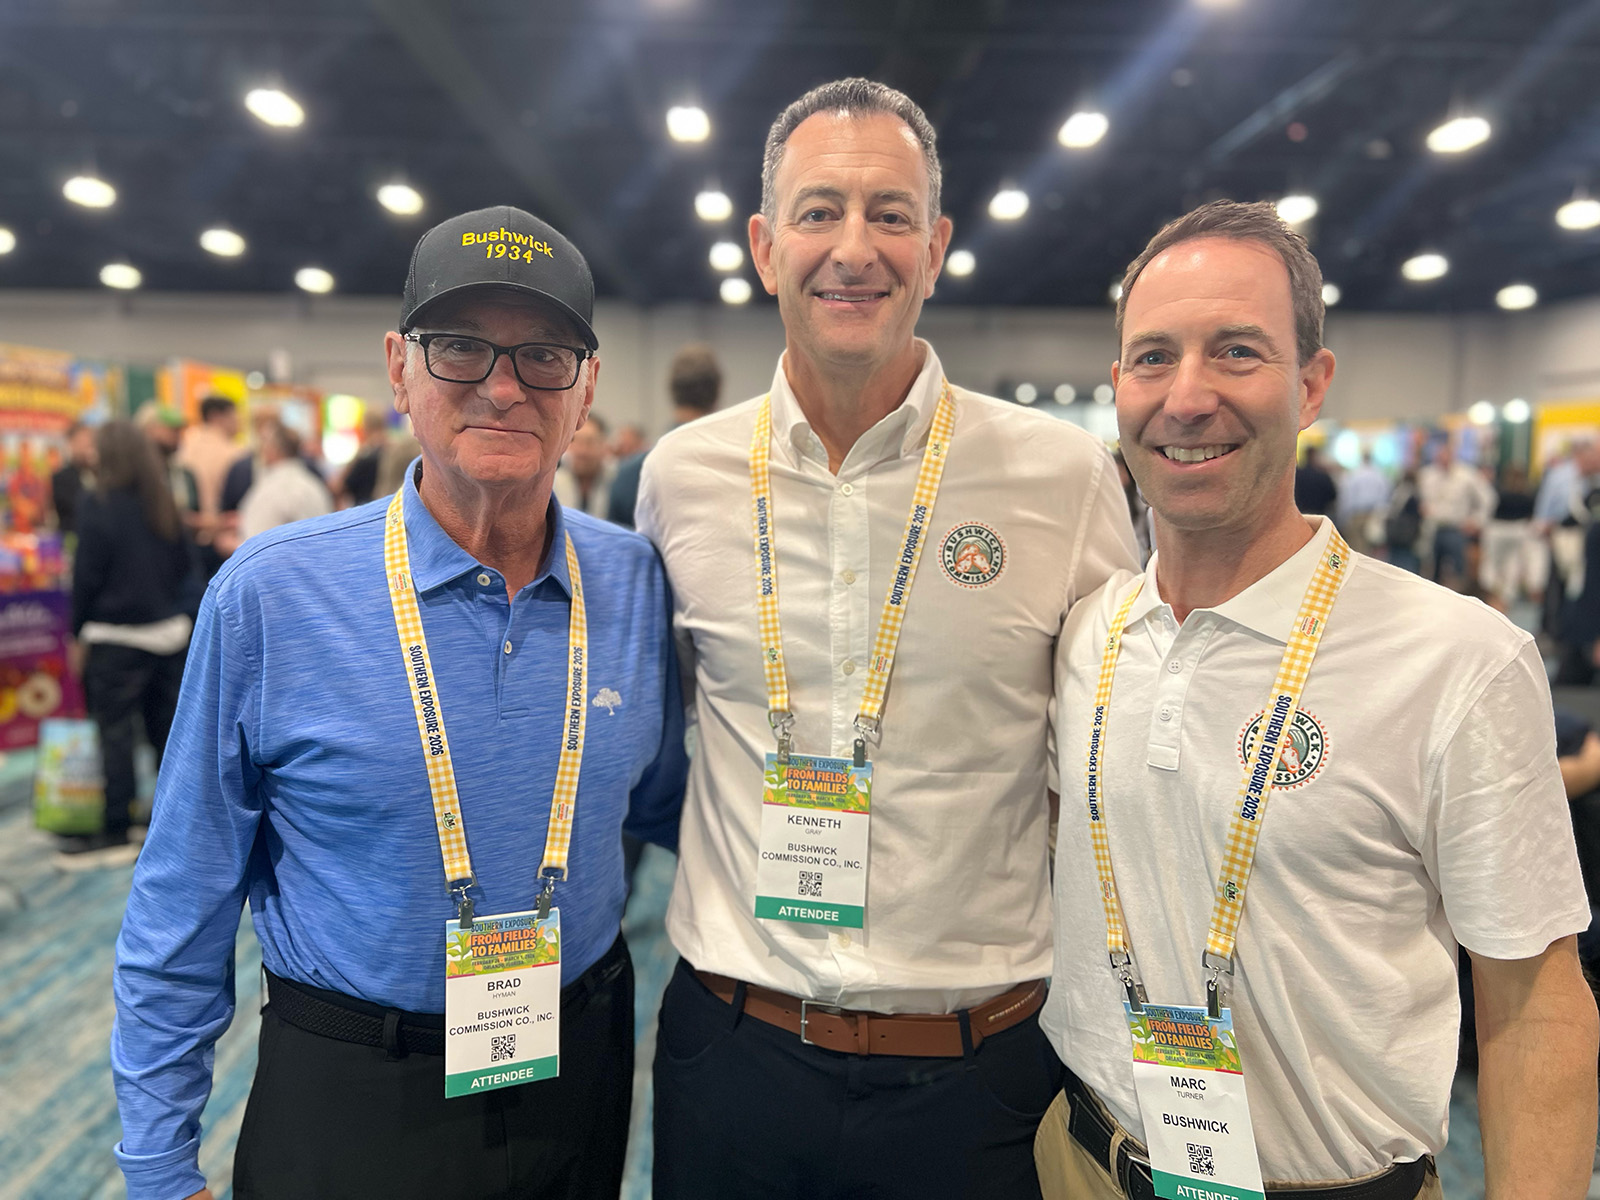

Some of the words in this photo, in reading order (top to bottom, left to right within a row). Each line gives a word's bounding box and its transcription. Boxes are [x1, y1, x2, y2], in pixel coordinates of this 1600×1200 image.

[462, 227, 554, 258] Bushwick
[486, 243, 534, 264] 1934
[946, 527, 1000, 553] BUSHWICK
[760, 537, 771, 576] EXPOSURE
[890, 564, 910, 606] SOUTHERN
[901, 524, 922, 564] EXPOSURE
[913, 504, 927, 523] 2026
[947, 559, 999, 582] COMMISSION
[409, 644, 430, 689] SOUTHERN
[573, 646, 583, 666] 2026
[572, 666, 583, 707] EXPOSURE
[419, 689, 440, 734] EXPOSURE
[1094, 705, 1104, 726] 2026
[1264, 695, 1292, 745] SOUTHERN
[567, 708, 580, 751] SOUTHERN
[428, 734, 444, 756] 2026
[1089, 727, 1101, 772] EXPOSURE
[788, 768, 815, 780] FROM
[816, 771, 848, 784] FIELDS
[1248, 744, 1276, 796] EXPOSURE
[788, 779, 800, 790] TO
[801, 780, 847, 794] FAMILIES
[1088, 774, 1100, 821] SOUTHERN
[1241, 794, 1260, 821] 2026
[787, 814, 841, 829] KENNETH
[805, 828, 822, 836] GRAY
[787, 843, 837, 855] BUSHWICK
[761, 851, 820, 865] COMMISSION
[822, 858, 842, 868] CO.,
[844, 860, 862, 869] INC.
[778, 905, 839, 922] ATTENDEE
[471, 932, 502, 946] FROM
[503, 928, 537, 942] FIELDS
[471, 945, 487, 957] TO
[488, 939, 537, 955] FAMILIES
[487, 977, 521, 992] BRAD
[492, 991, 516, 999] HYMAN
[477, 1004, 530, 1021] BUSHWICK
[449, 1020, 513, 1036] COMMISSION
[515, 1016, 535, 1026] CO.,
[536, 1012, 555, 1022] INC.
[1149, 1020, 1177, 1033] FROM
[1177, 1023, 1210, 1037] FIELDS
[1153, 1031, 1166, 1044] TO
[1166, 1033, 1213, 1050] FAMILIES
[471, 1067, 534, 1089] ATTENDEE
[1170, 1076, 1206, 1091] MARC
[1176, 1090, 1204, 1101] TURNER
[1163, 1113, 1229, 1135] BUSHWICK
[1177, 1184, 1239, 1200] ATTEND
